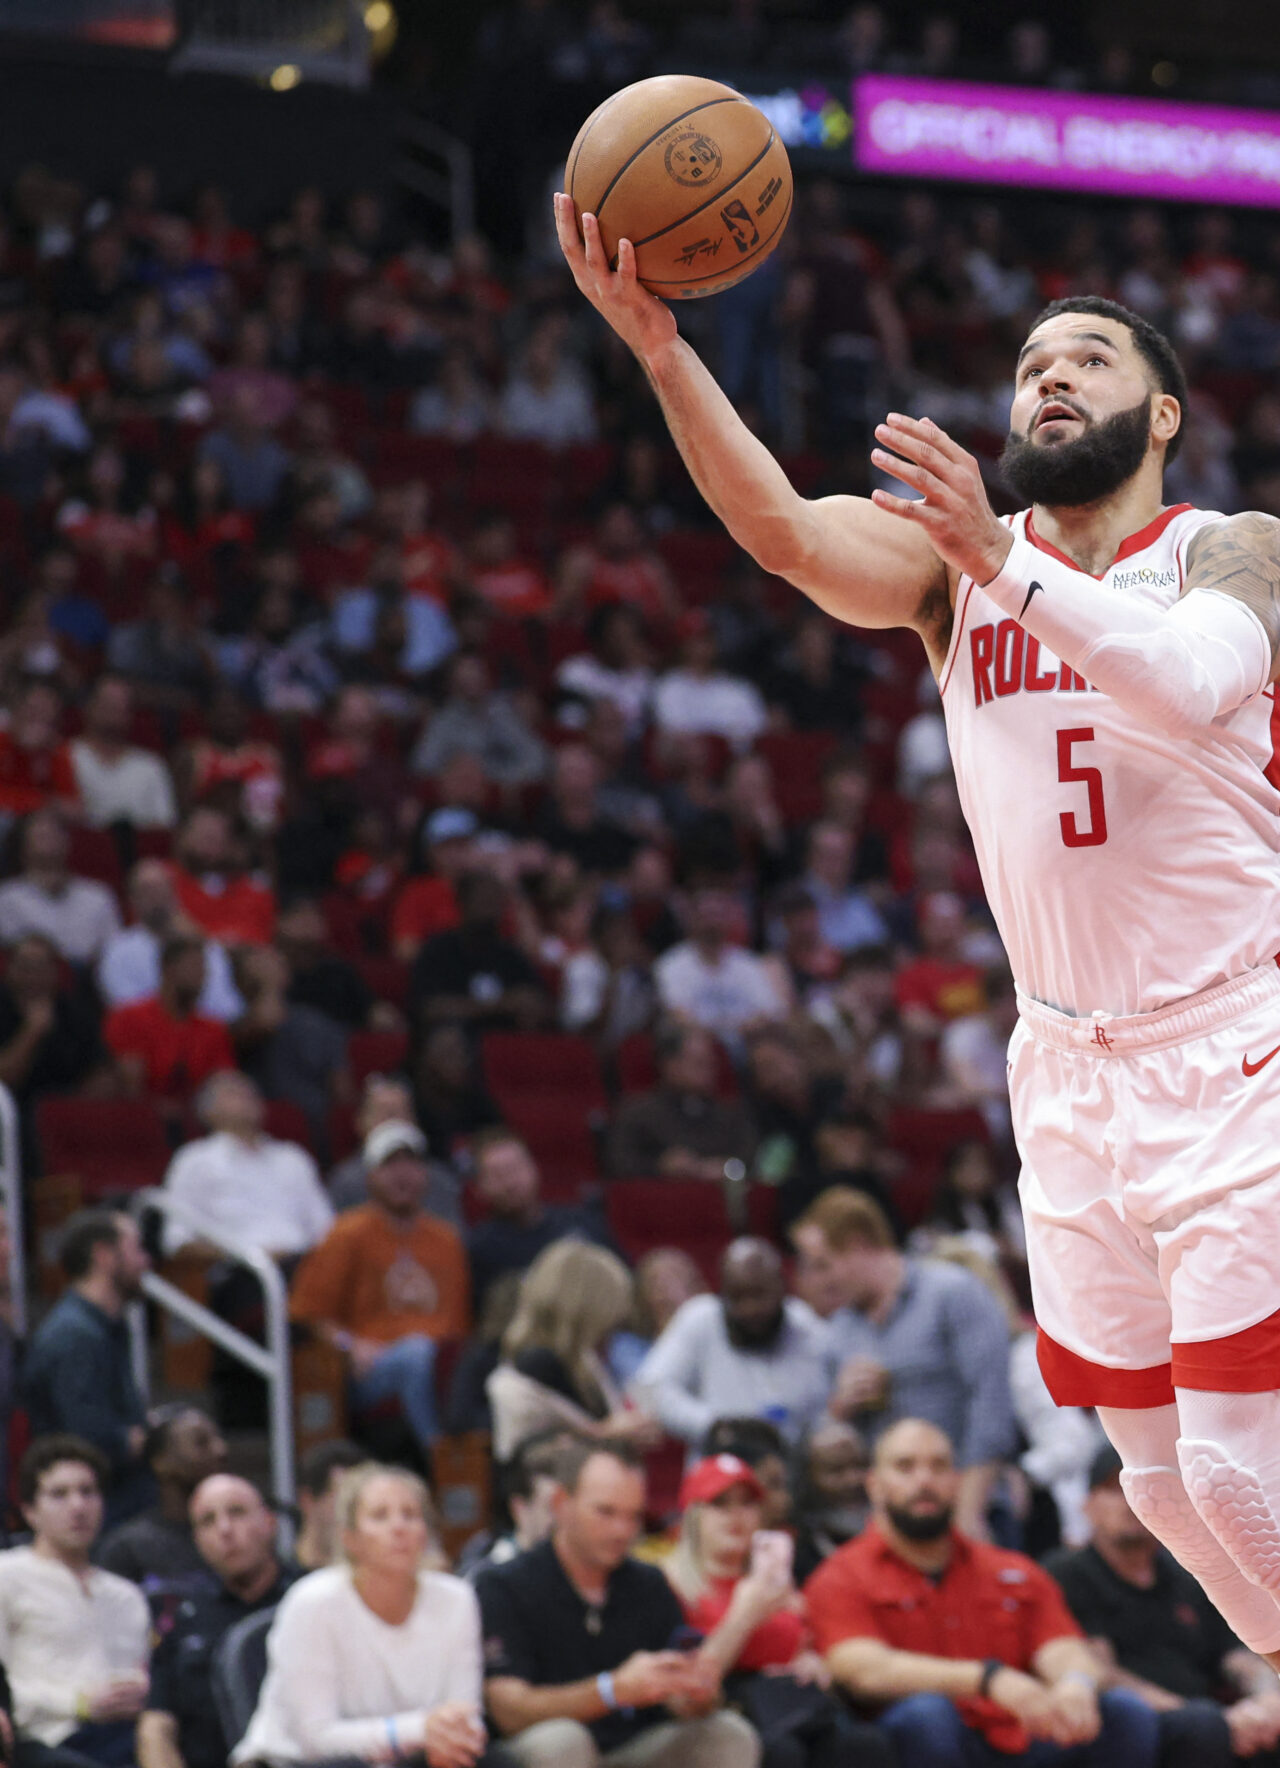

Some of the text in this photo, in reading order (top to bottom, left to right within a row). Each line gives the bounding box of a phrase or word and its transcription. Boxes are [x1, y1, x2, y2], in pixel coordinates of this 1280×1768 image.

[870, 99, 1060, 166] OFFICIAL
[1064, 115, 1219, 179] ENERGY
[1113, 568, 1176, 582] MEMORIAL
[1113, 575, 1176, 589] HERMANN
[1056, 727, 1108, 848] 5
